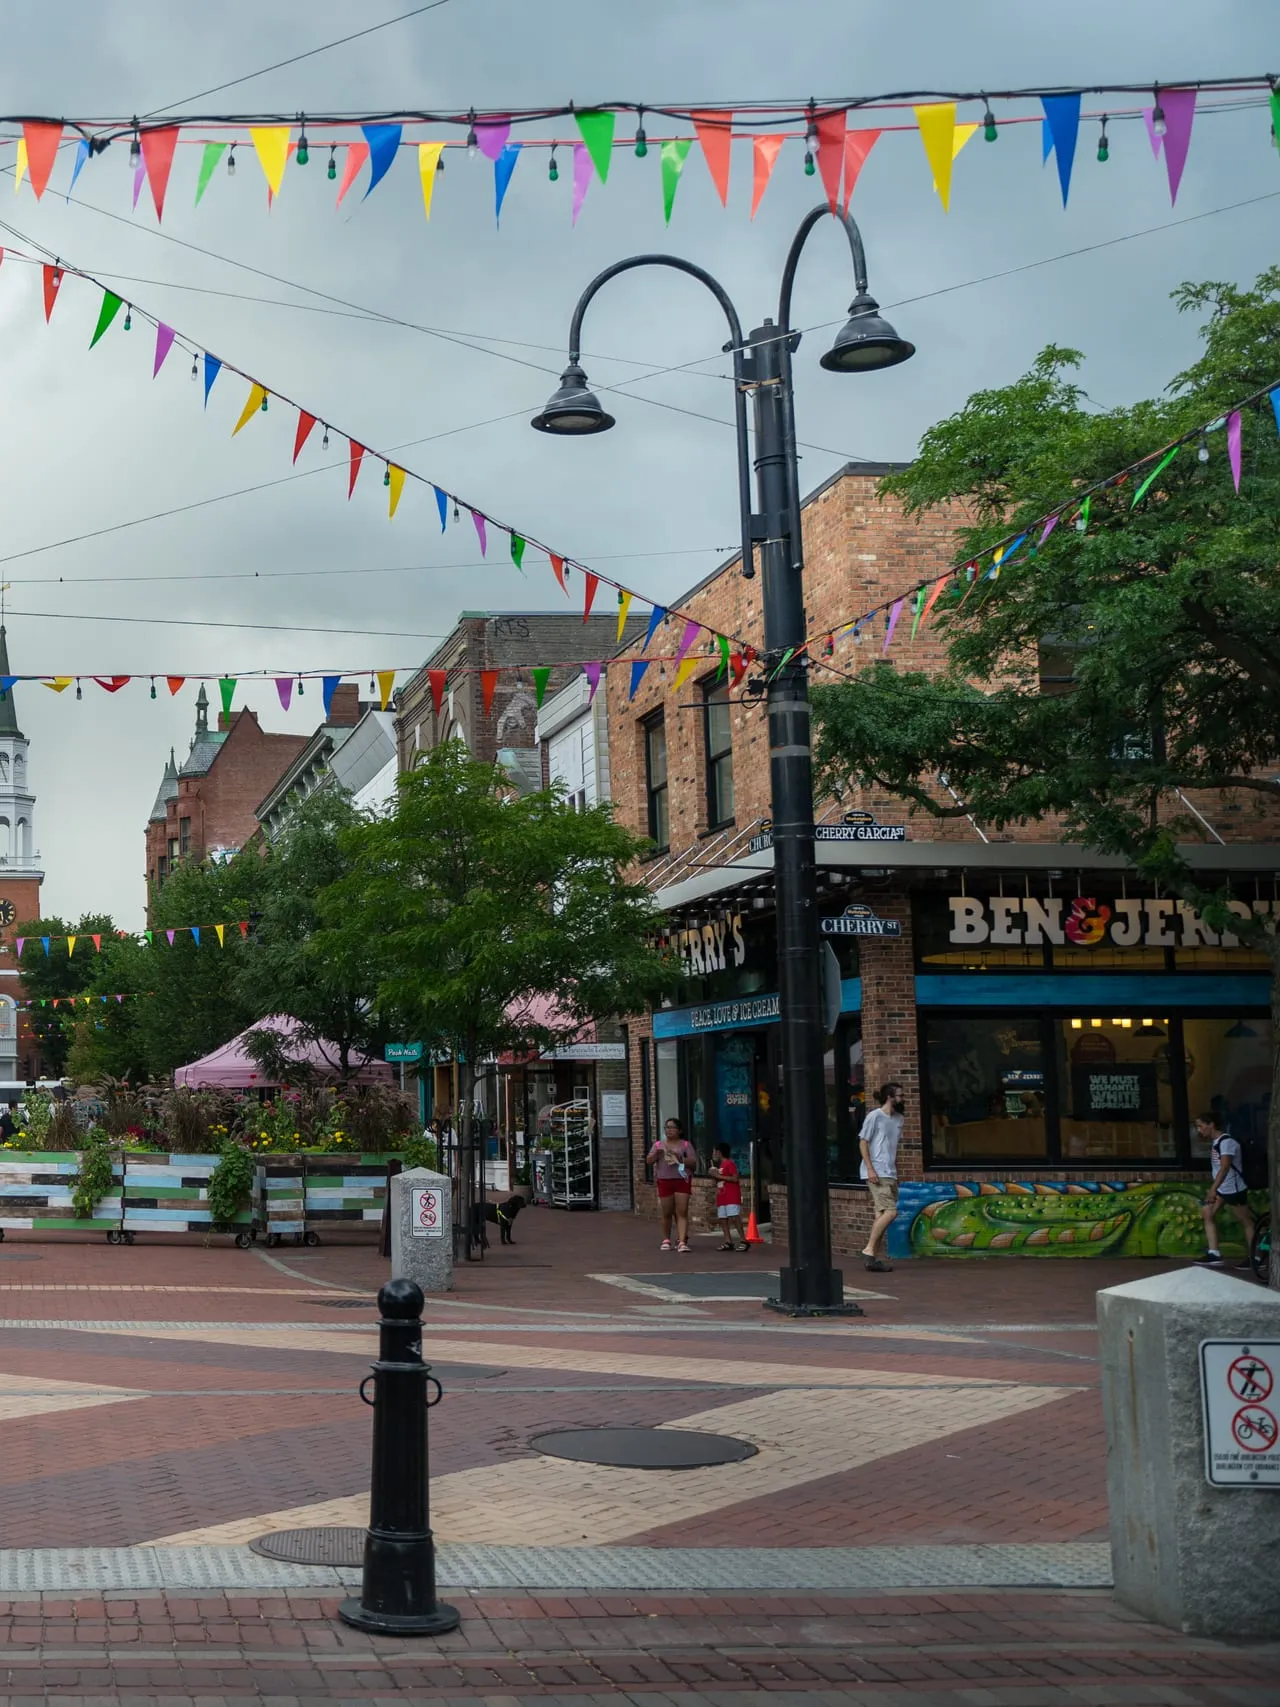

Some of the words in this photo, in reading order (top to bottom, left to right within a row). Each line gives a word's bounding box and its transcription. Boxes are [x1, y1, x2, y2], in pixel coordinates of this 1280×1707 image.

[815, 827, 857, 840] CHERRY
[857, 827, 898, 840] GARCIA
[748, 832, 774, 853] CHURC
[821, 918, 886, 935] CHERRY
[886, 921, 899, 930] ST
[713, 1004, 731, 1025] LOVE
[731, 1003, 740, 1022] &
[740, 1001, 752, 1021] ICE
[752, 996, 781, 1019] CREAM
[1089, 1074, 1108, 1084] WE
[1109, 1074, 1140, 1084] MUST
[1090, 1091, 1140, 1102] WHITE
